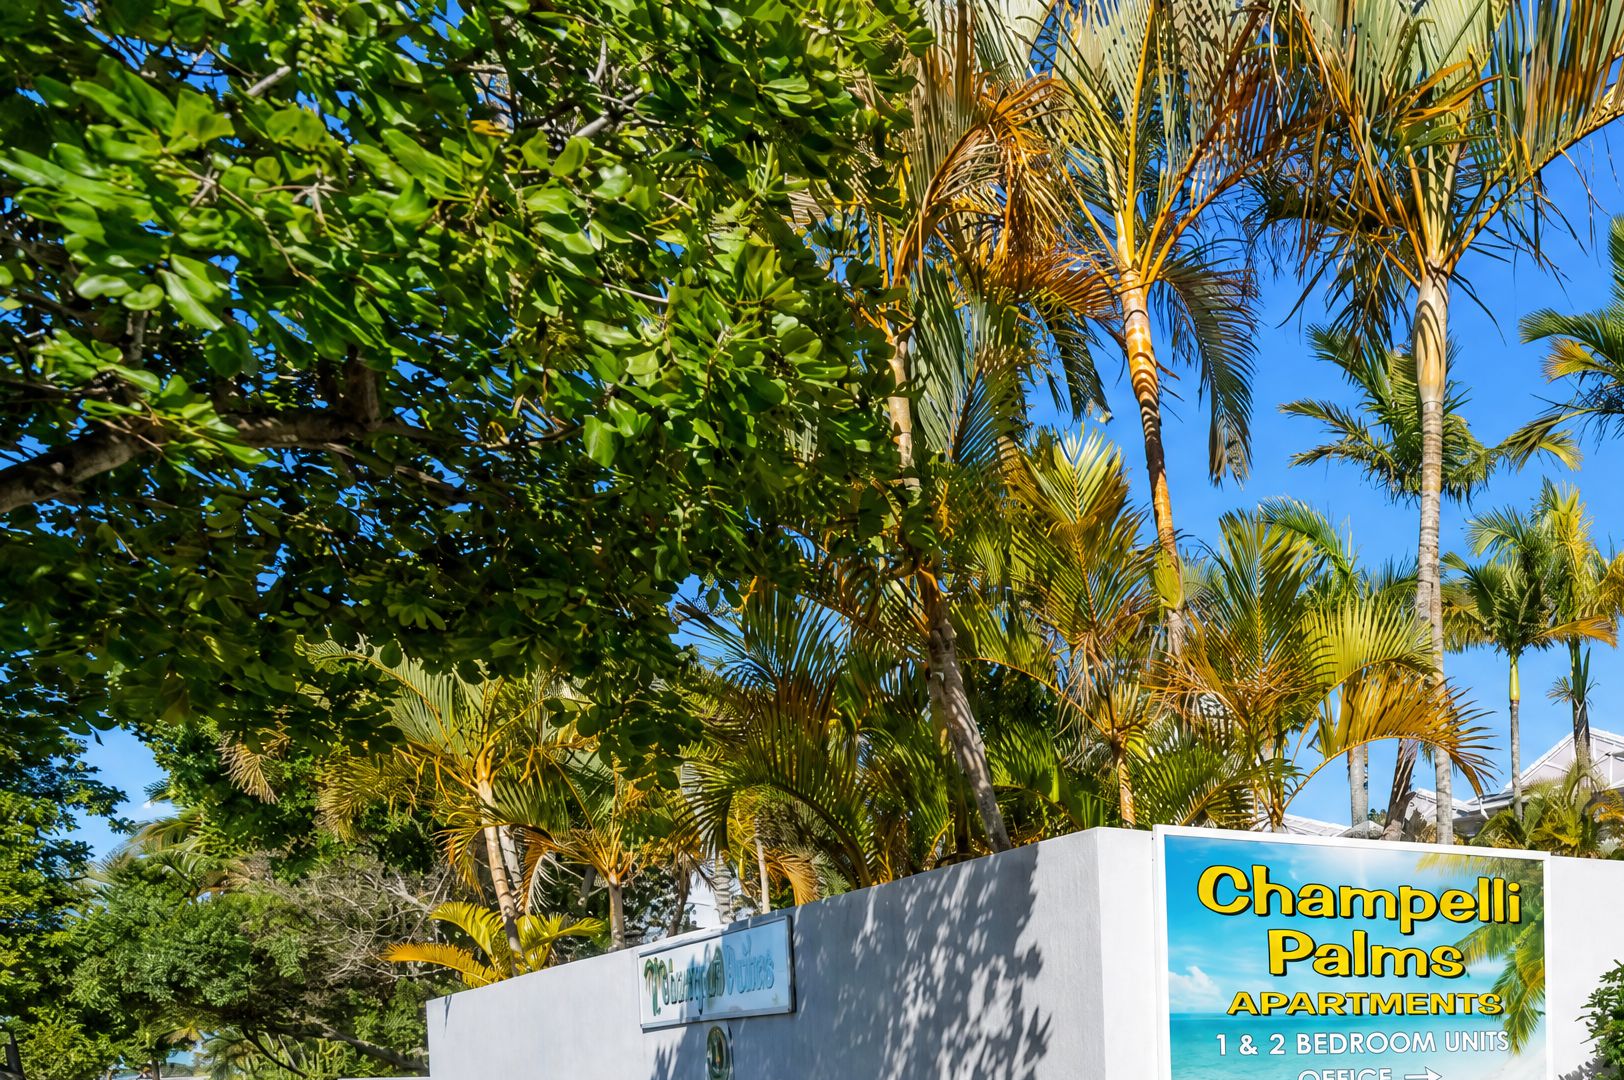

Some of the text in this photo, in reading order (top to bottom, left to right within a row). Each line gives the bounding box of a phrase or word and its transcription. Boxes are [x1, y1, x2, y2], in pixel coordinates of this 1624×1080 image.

[1196, 864, 1523, 935] Champelli
[1267, 929, 1466, 978] Palms
[1226, 990, 1504, 1016] APARTMENTS
[1216, 1030, 1510, 1056] 1 & 2 BEDROOM UNITS
